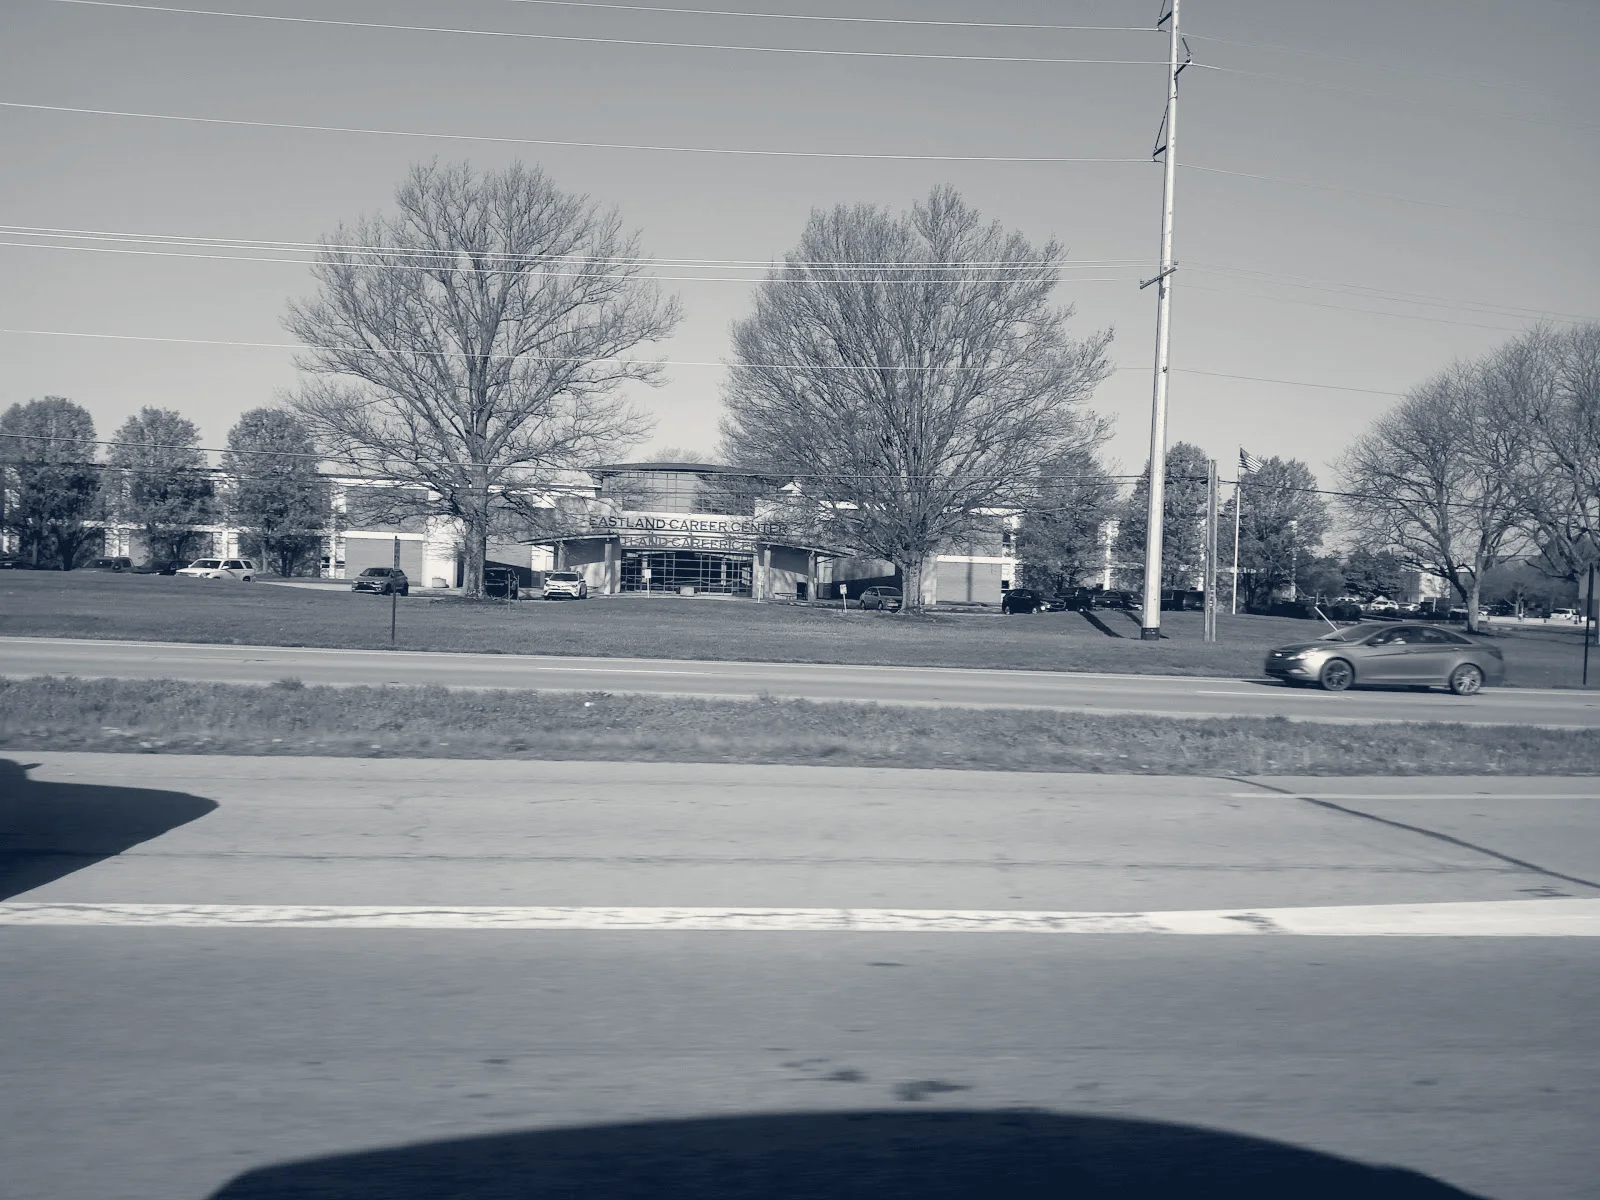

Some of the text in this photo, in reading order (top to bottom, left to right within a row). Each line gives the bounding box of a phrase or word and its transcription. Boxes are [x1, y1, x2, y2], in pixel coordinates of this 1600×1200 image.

[589, 516, 788, 534] EASTLAND CAREER CENTER
